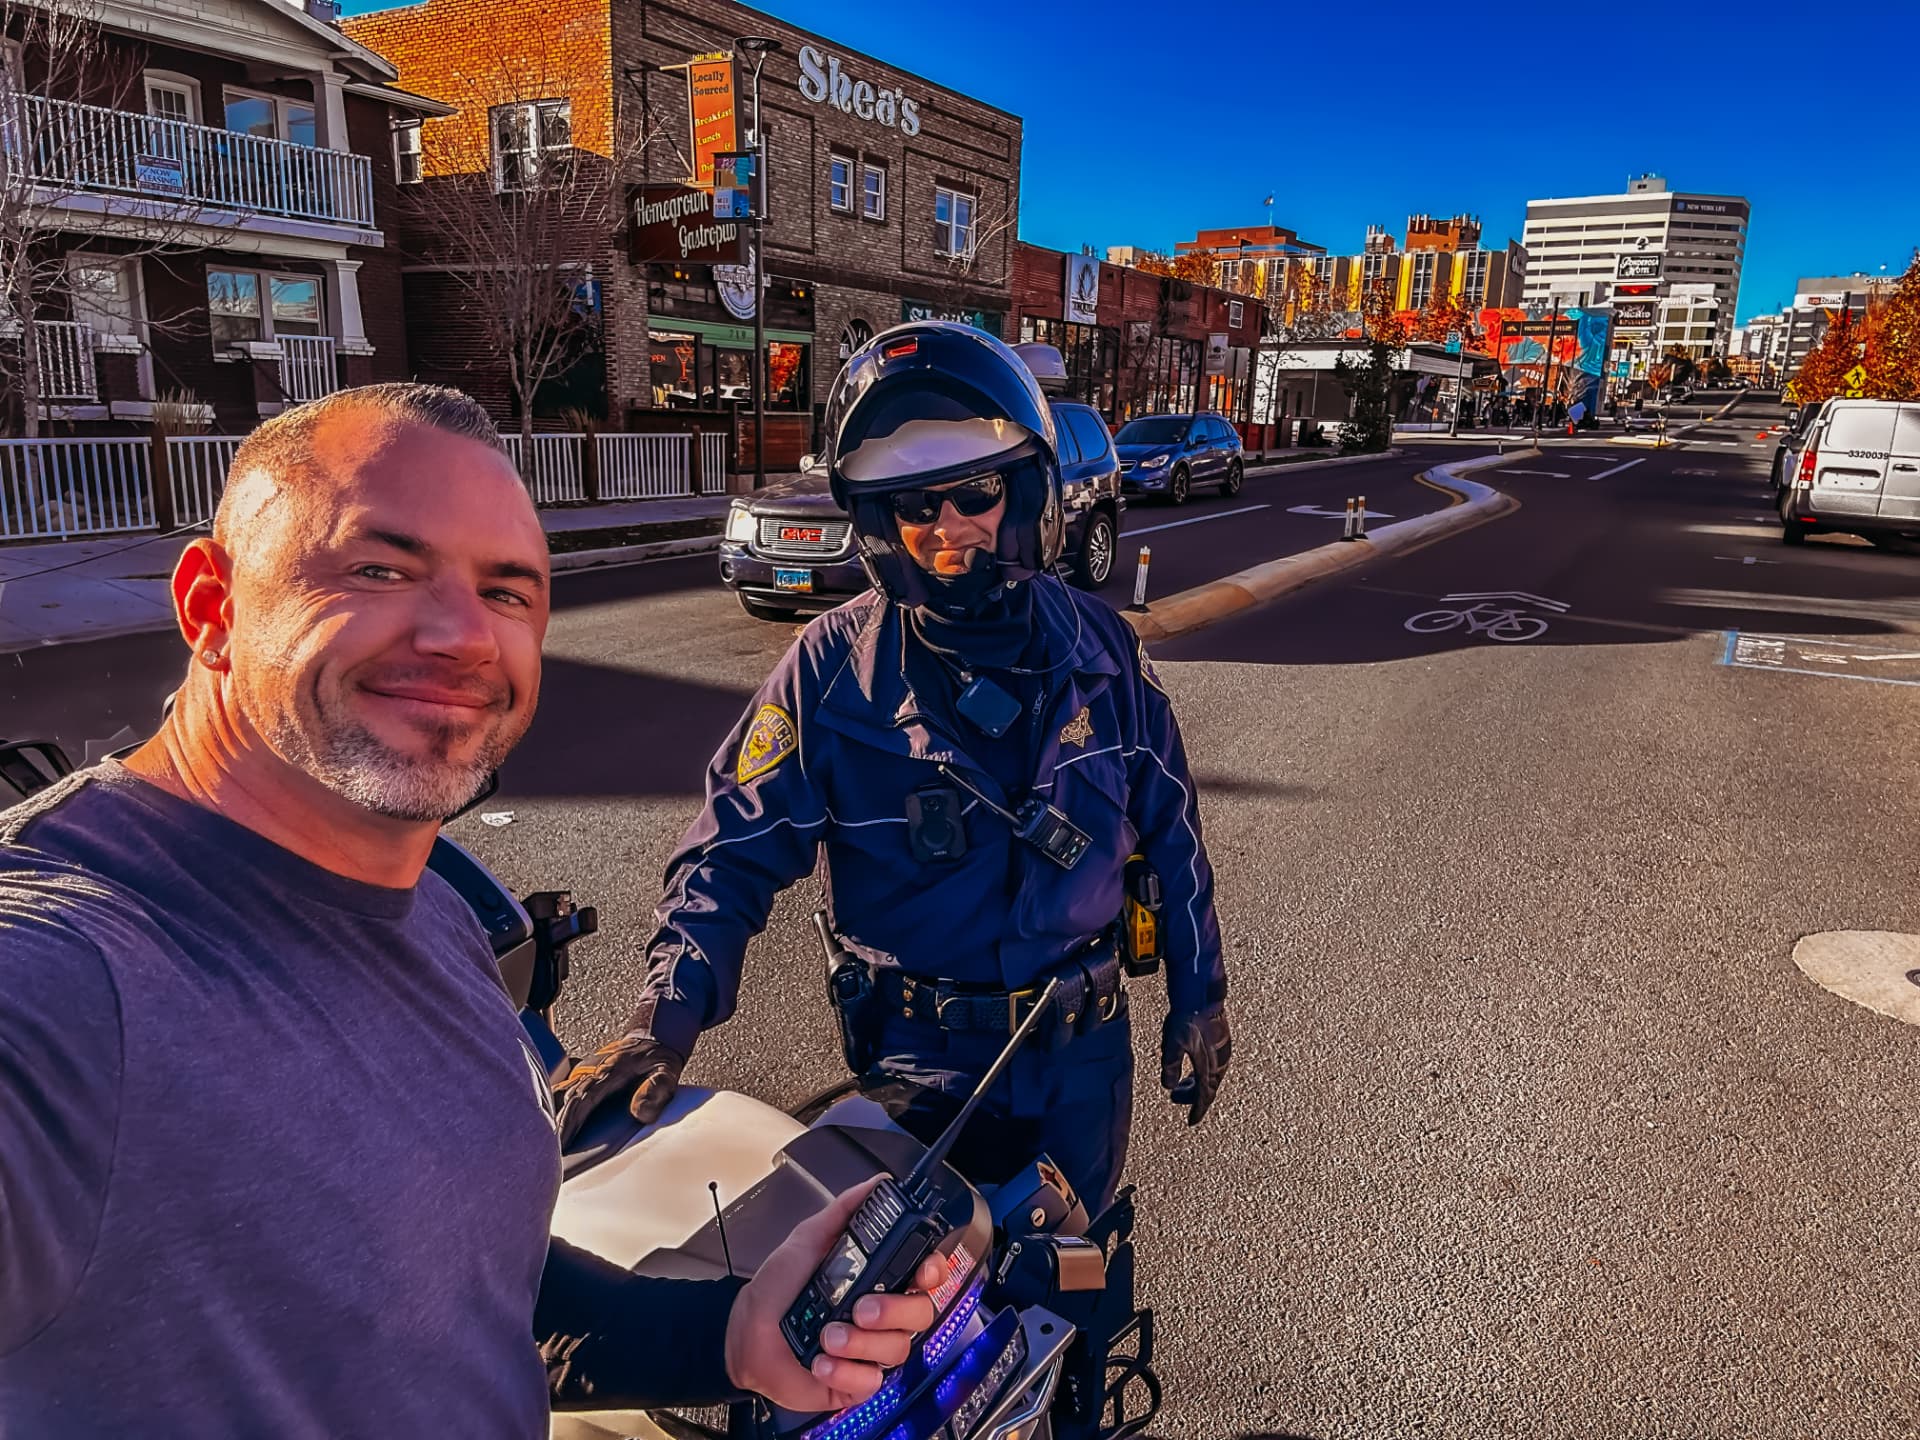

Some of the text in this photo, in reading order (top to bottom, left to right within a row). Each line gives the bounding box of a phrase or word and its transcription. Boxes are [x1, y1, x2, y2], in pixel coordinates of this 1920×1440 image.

[693, 70, 725, 83] Locally
[693, 83, 729, 97] Sourced
[798, 45, 921, 137] Shea's
[694, 108, 733, 128] Breakfast
[696, 131, 721, 146] Lunch
[150, 168, 170, 177] NOW
[633, 190, 709, 228] Homegrown
[678, 223, 737, 259] Gastropub
[1847, 449, 1890, 460] 3320039
[781, 527, 824, 542] GMC
[758, 709, 793, 751] POLICE
